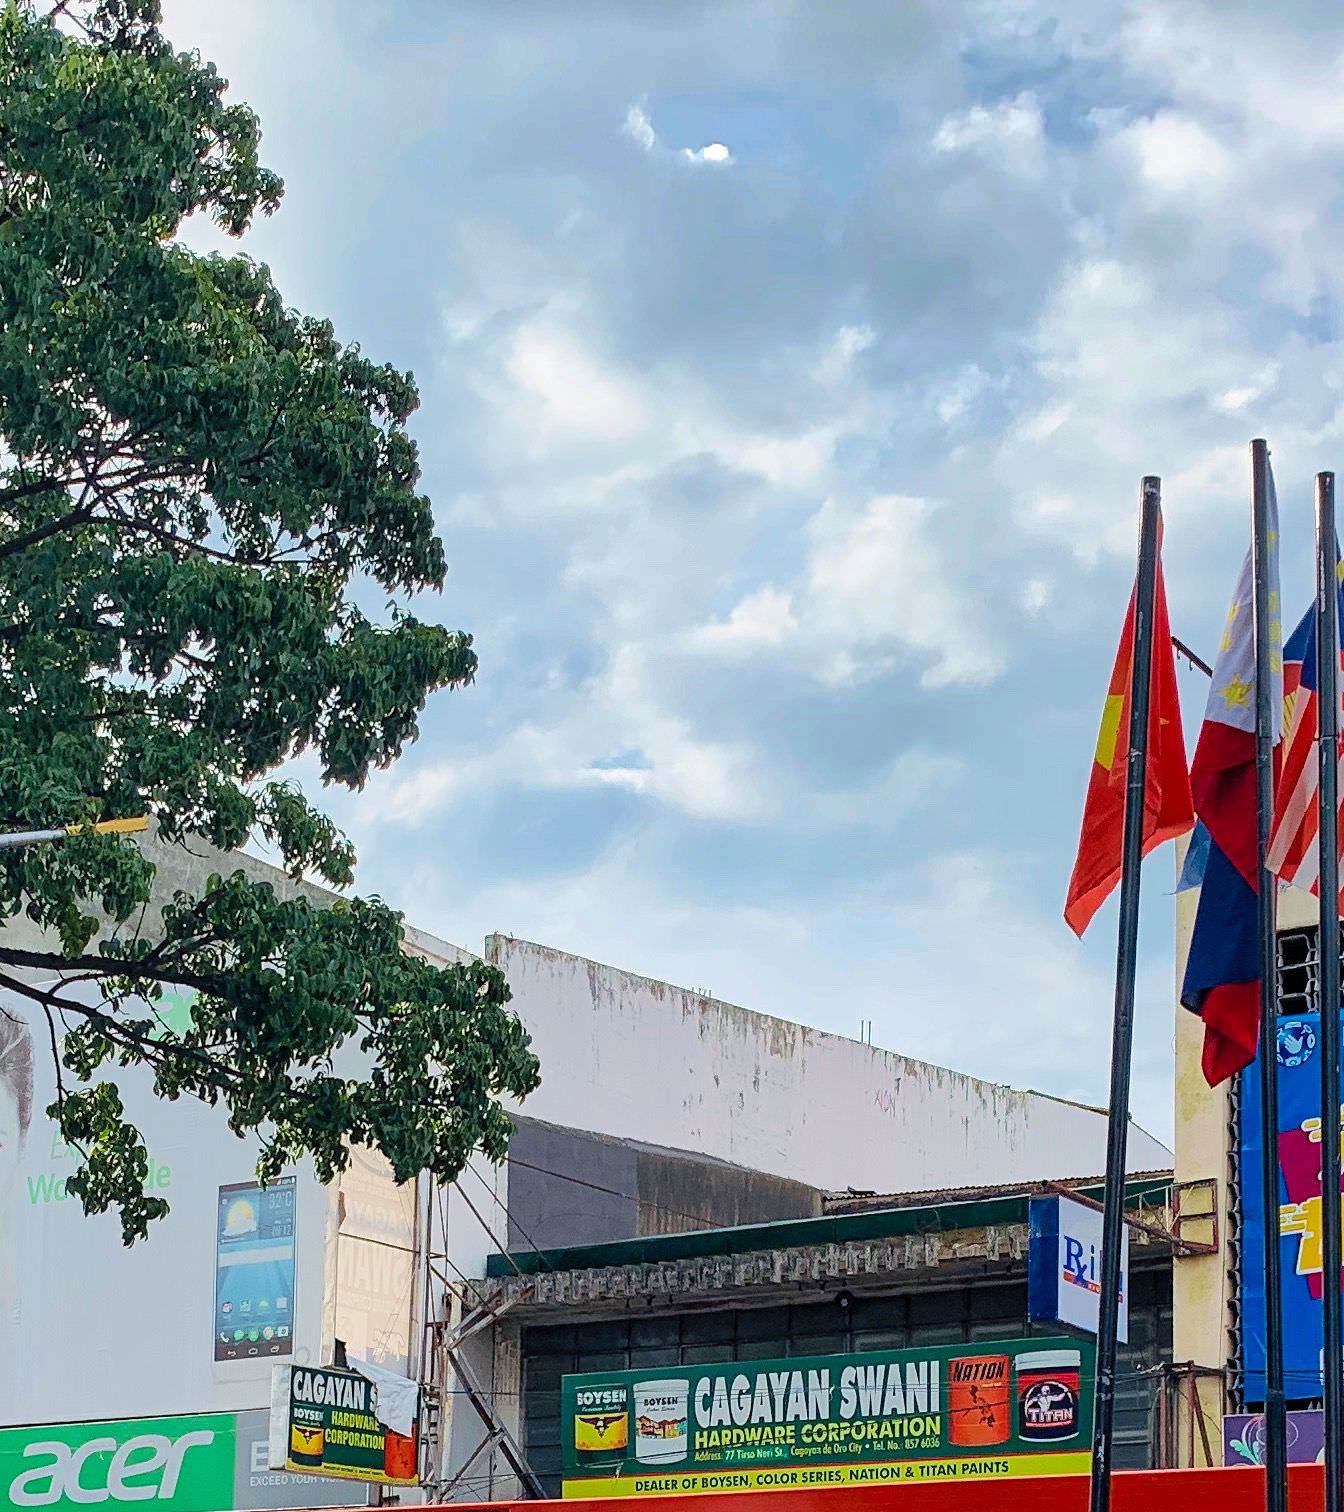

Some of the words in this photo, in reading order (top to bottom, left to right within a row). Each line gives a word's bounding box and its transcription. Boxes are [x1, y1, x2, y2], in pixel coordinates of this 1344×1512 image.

[953, 1361, 1006, 1383] NATION
[292, 1370, 366, 1411] CAGAYAN
[576, 1388, 627, 1407] BOYSEN
[695, 1368, 831, 1429] CAGAYAN
[839, 1360, 941, 1420] SWANI
[643, 1396, 679, 1407] BOYSEN
[294, 1407, 324, 1422] BOYSEN
[331, 1411, 380, 1432] HARDWARE
[1027, 1407, 1074, 1423] TITAN
[325, 1428, 385, 1451] CORPORATION
[695, 1425, 796, 1450] HARDWARE
[800, 1416, 941, 1443] CORPORATION
[725, 1449, 735, 1460] 77
[822, 1444, 833, 1455] de
[833, 1442, 848, 1454] Oro
[848, 1443, 863, 1455] City
[905, 1439, 918, 1449] 857
[8, 1429, 215, 1507] acer
[635, 1478, 679, 1492] DEALER
[682, 1477, 699, 1490] OF
[702, 1474, 752, 1489] BOYSEN,
[756, 1473, 798, 1486] COLOR
[802, 1470, 846, 1484] SERIES,
[849, 1467, 901, 1480] NATION
[905, 1466, 915, 1478] &
[919, 1463, 957, 1476] TITAN
[961, 1461, 1009, 1475] PAINTS
[250, 1475, 289, 1488] EXCEED
